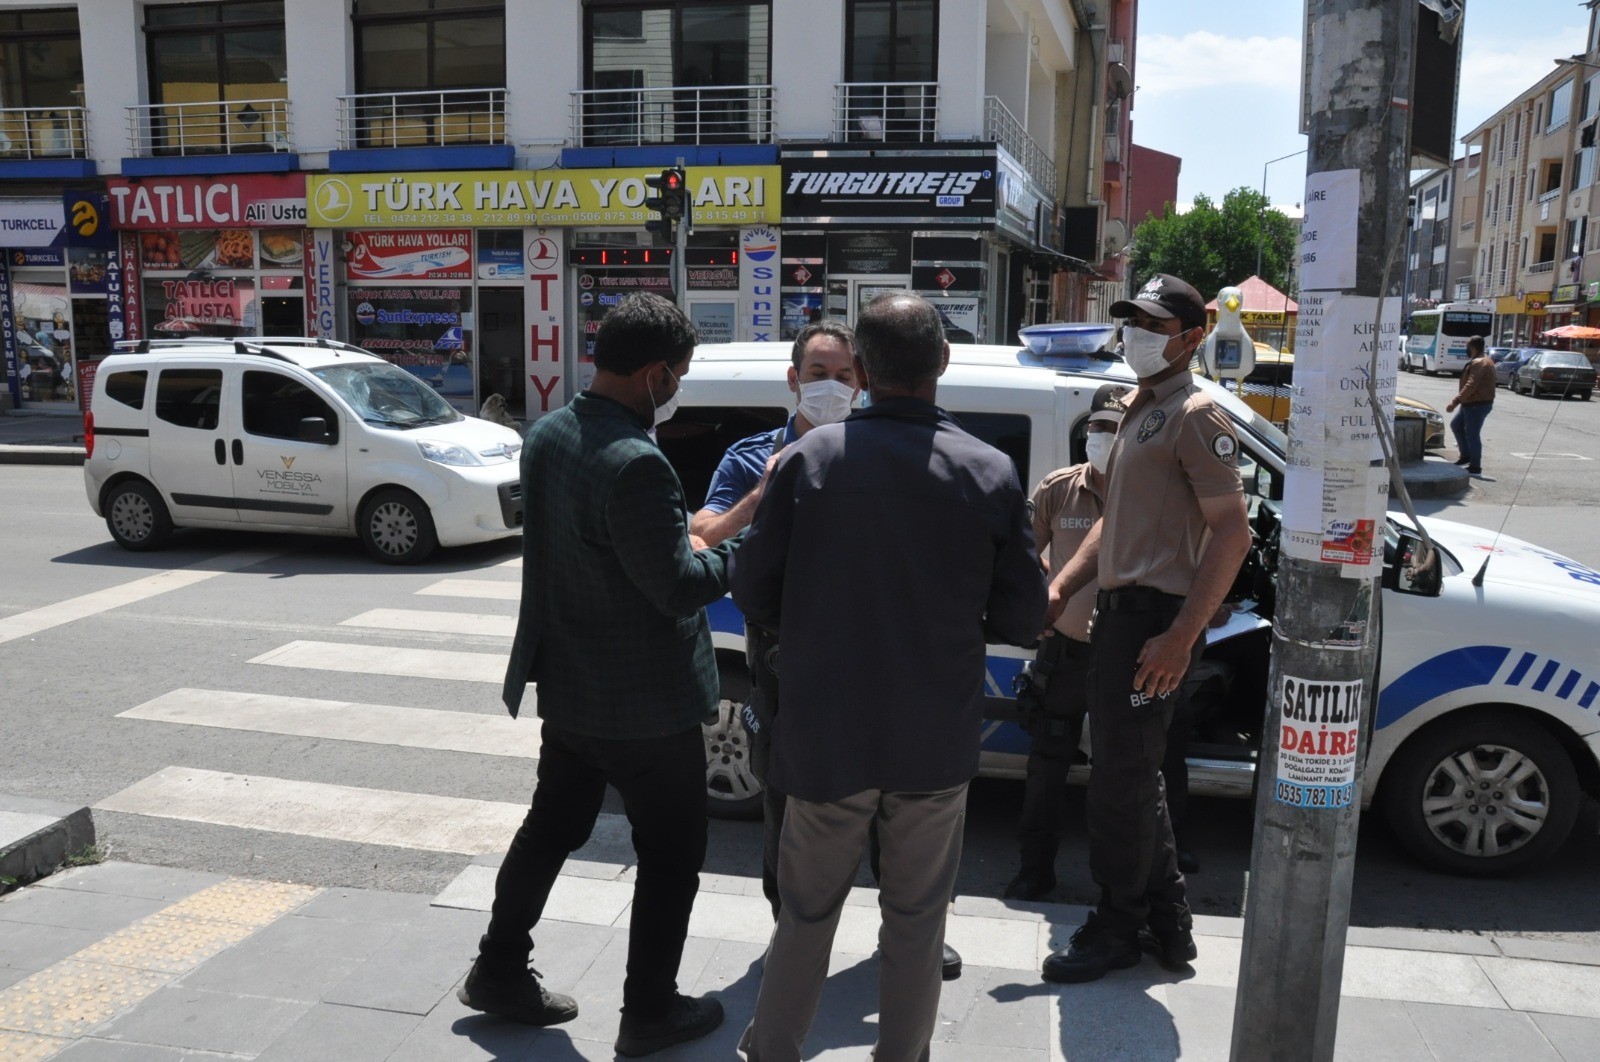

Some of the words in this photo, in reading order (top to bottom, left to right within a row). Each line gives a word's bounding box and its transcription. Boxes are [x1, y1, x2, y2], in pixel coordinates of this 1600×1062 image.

[362, 177, 462, 212] TÜRK
[474, 179, 580, 210] HAVA
[591, 176, 766, 207] YOARI
[939, 197, 960, 205] GROUP
[111, 184, 239, 223] TATLICI
[246, 204, 266, 221] Ali
[272, 204, 306, 220] Usta
[2, 219, 58, 230] TURKCELL
[391, 214, 417, 222] 0474
[421, 214, 439, 222] 212
[443, 214, 456, 222] 34
[460, 213, 472, 222] 38
[484, 213, 503, 222] 212
[507, 213, 520, 222] 89
[524, 213, 537, 222] 90
[604, 211, 626, 220] 875
[630, 211, 643, 220] 38
[707, 211, 728, 219] 815
[732, 210, 746, 219] 49
[752, 210, 765, 219] 11
[368, 233, 395, 247] TÜRK
[398, 234, 423, 246] HAVA
[426, 234, 468, 246] YOLLARI
[25, 254, 59, 262] TURKCELL
[107, 251, 121, 313] FATURA
[125, 250, 136, 305] HALKA
[162, 280, 235, 298] TATLICI
[414, 289, 461, 299] YOLLARI
[165, 302, 186, 319] Ali
[193, 303, 235, 319] USTA
[377, 309, 458, 326] SunExpress
[1341, 415, 1367, 427] FUL
[256, 469, 322, 482] VENESSA
[1283, 679, 1361, 724] SATILIK
[1281, 724, 1357, 756] DAİRE
[1278, 782, 1302, 805] 0535
[1306, 788, 1326, 805] 782
